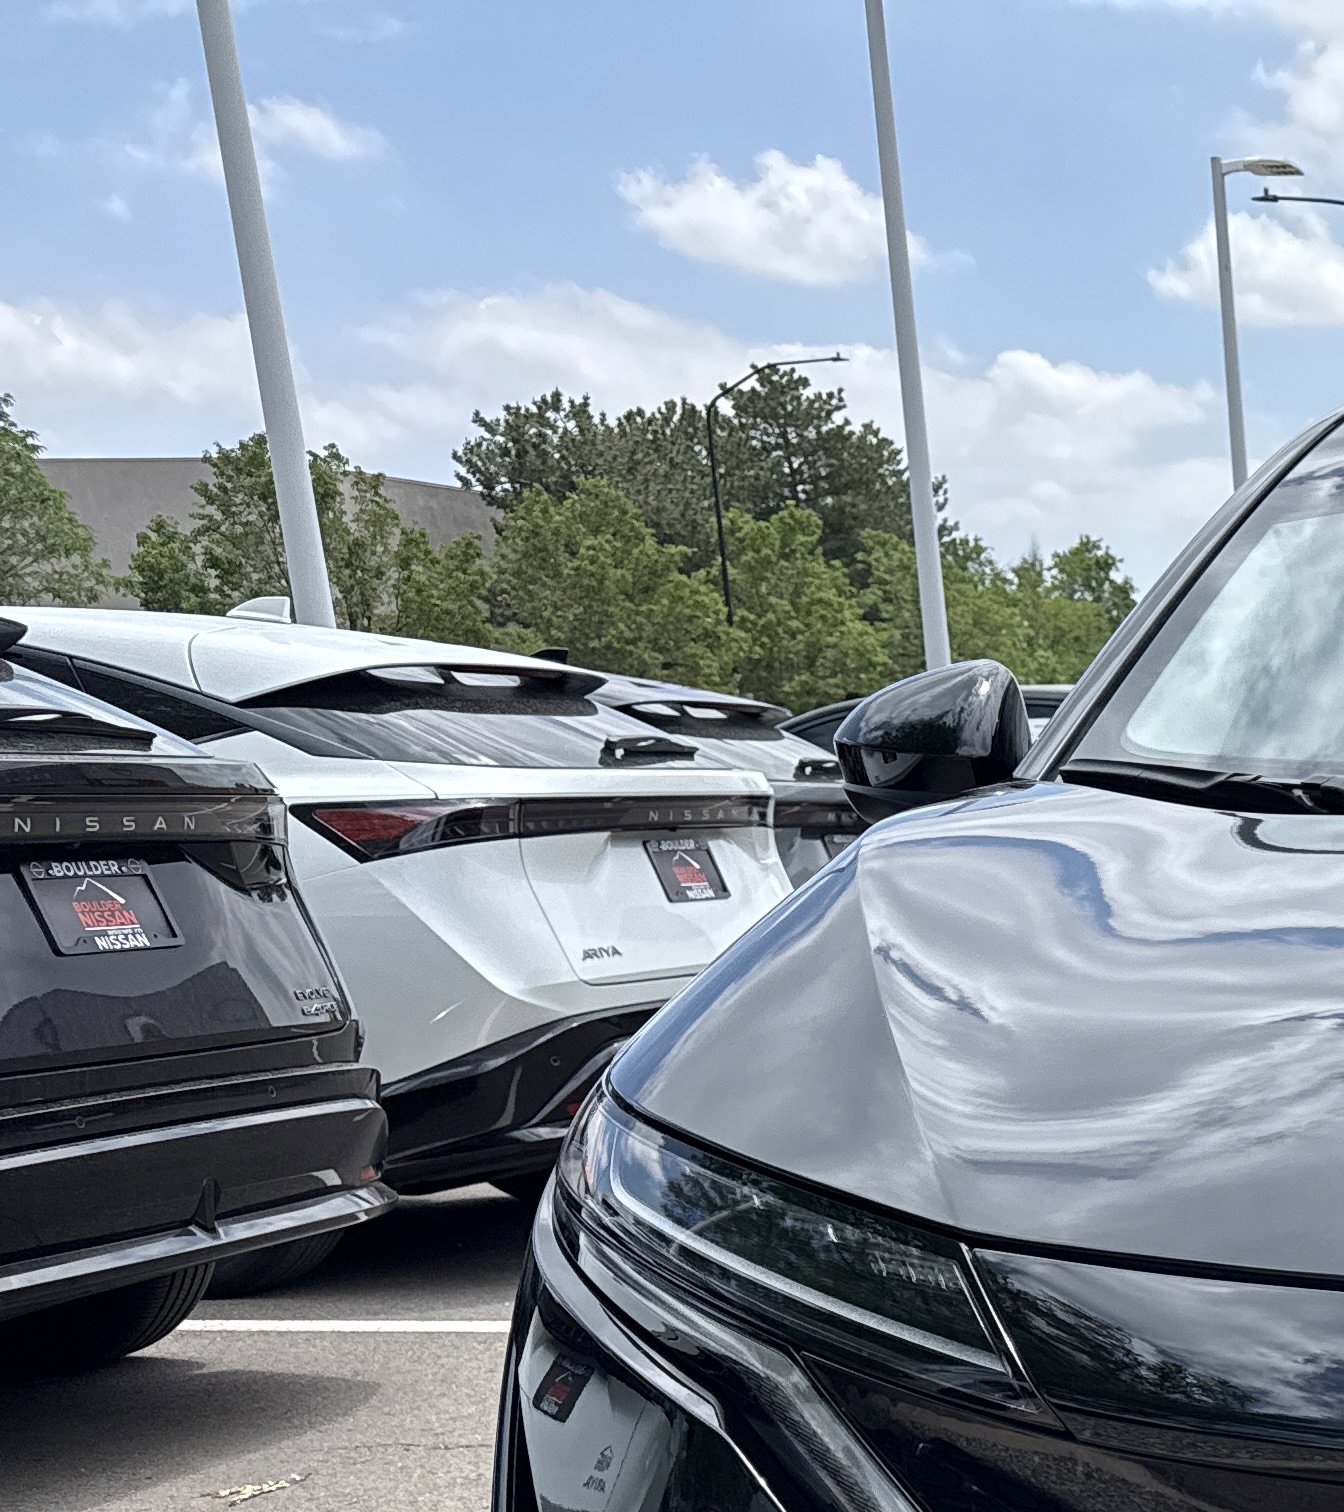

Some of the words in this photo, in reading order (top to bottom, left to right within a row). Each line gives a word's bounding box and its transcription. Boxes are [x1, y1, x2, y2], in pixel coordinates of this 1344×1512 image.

[14, 815, 196, 834] NISSAN
[52, 860, 122, 877] BOULDER
[72, 899, 124, 913] BOULDER
[77, 909, 138, 927] NISSAN
[94, 931, 150, 950] NISSAN
